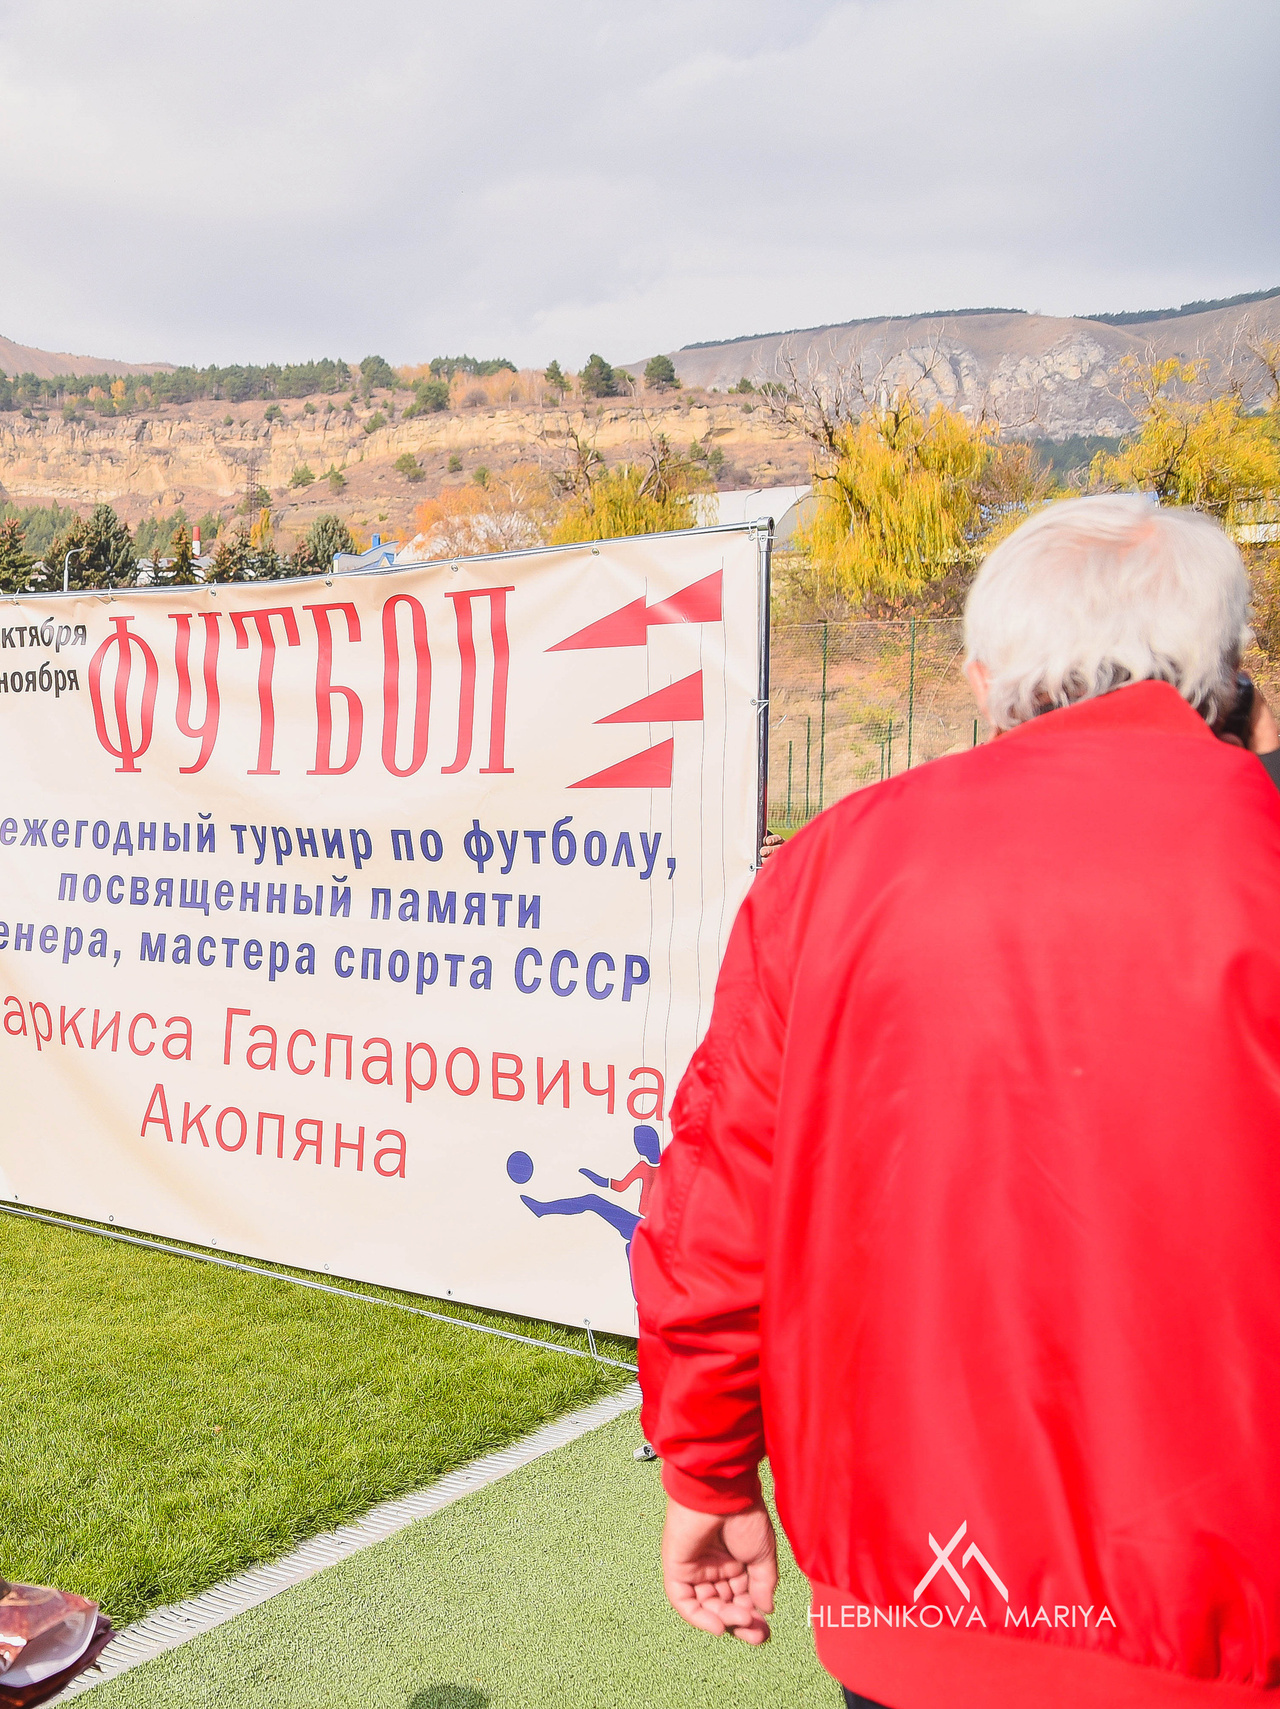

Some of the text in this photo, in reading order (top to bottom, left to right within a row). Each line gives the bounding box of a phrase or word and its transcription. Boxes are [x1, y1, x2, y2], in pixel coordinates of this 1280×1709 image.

[87, 585, 516, 778] ФУТБОЛ
[0, 812, 217, 858] ежегодный
[231, 823, 374, 869] турнир
[391, 828, 444, 863] по
[463, 815, 677, 881] футболу,
[57, 871, 542, 930] посвященный памяти
[139, 931, 316, 982] мастера
[334, 945, 493, 995] спорта
[513, 947, 651, 1003] СССР
[222, 1007, 666, 1123] Гаспаровича
[139, 1083, 408, 1179] Акопяна
